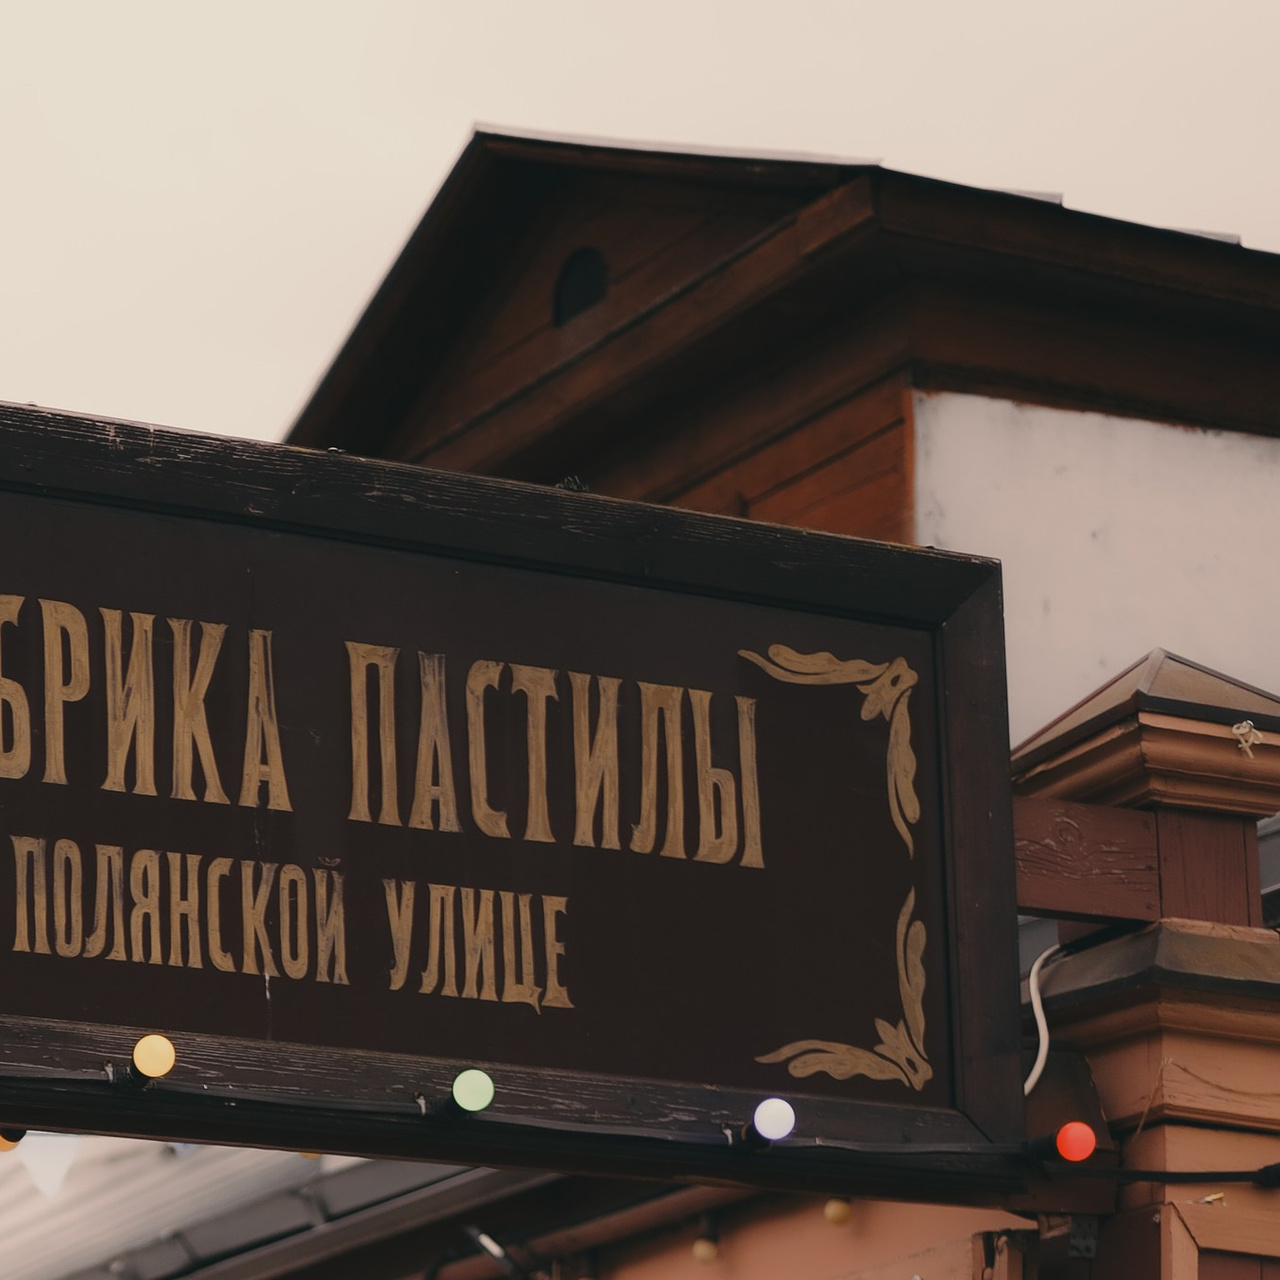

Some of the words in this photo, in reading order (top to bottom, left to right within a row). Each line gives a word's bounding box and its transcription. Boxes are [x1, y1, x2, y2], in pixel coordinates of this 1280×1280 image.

[345, 641, 765, 868] ПАСТИЛЫ
[9, 835, 351, 985] ПОЛЯНСКОЙ
[382, 878, 575, 1016] УЛИЦЕ
